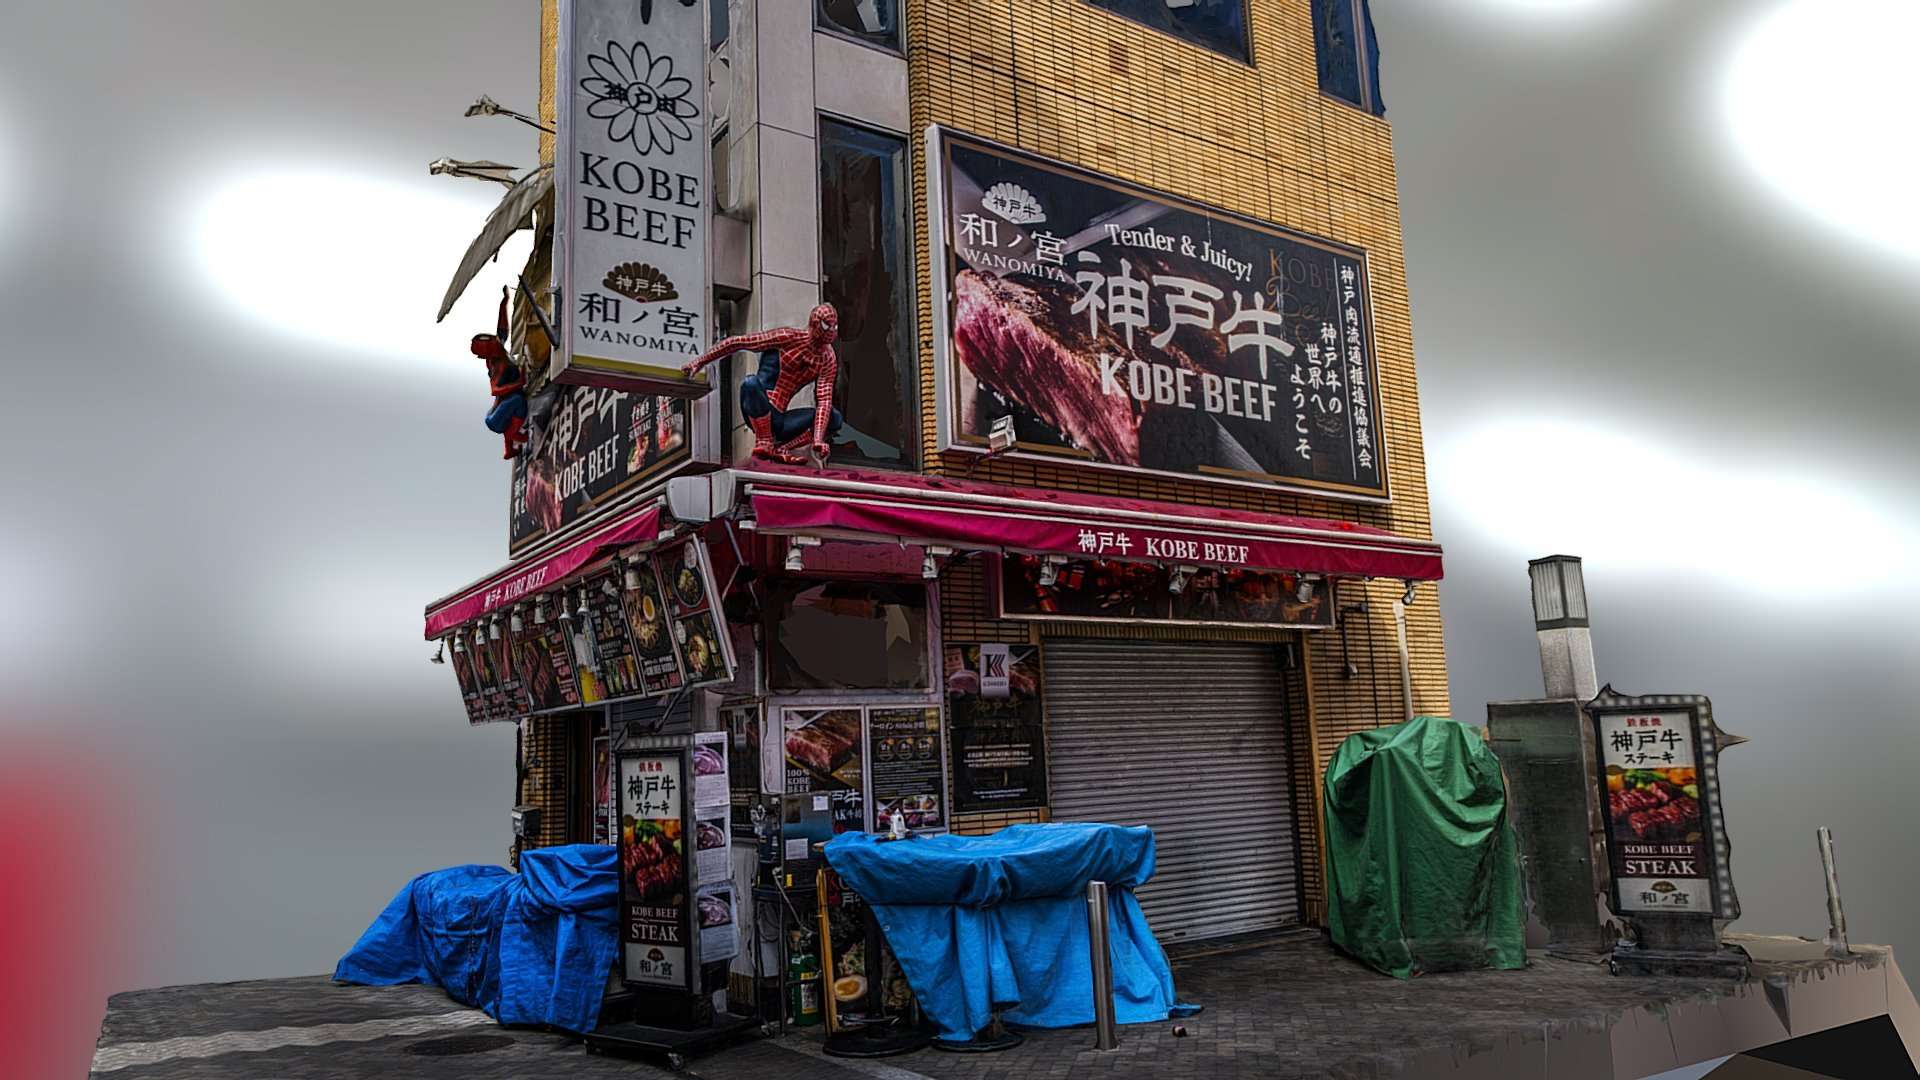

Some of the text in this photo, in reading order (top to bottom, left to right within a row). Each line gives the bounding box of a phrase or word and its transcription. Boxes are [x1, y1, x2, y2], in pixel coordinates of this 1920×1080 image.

[580, 151, 700, 209] KOBE
[583, 196, 696, 249] BEEF
[993, 195, 1036, 217] 神戸牛
[960, 213, 1068, 265] 和ノ宮
[1104, 223, 1252, 282] Tender & Juicy!
[963, 248, 1066, 282] WANOMIYA
[616, 274, 668, 297] 神戸牛
[579, 292, 699, 338] 和ノ宮
[1070, 251, 1295, 380] 神戸牛
[579, 326, 699, 355] WANOMIYA
[1305, 343, 1326, 413] 世界へ
[1320, 322, 1342, 414] 神戸牛の
[1100, 353, 1277, 422] KOBE BEEF
[1290, 364, 1312, 460] ようこそ
[554, 434, 619, 502] KOBE BEEF
[1078, 529, 1249, 564] 神戸牛 KOBE BEEF
[504, 577, 526, 601] KOBE
[526, 566, 548, 592] BEEF
[1610, 729, 1683, 752] 神戸牛
[1624, 751, 1675, 765] ステーキ
[627, 774, 676, 800] 神戸牛
[787, 777, 810, 785] KOBE
[636, 800, 670, 815] ステーキ
[1624, 844, 1694, 855] KOBE BEEF
[1625, 860, 1696, 875] STEAK
[631, 906, 679, 919] KOBE BEEF
[631, 923, 679, 942] STEAK
